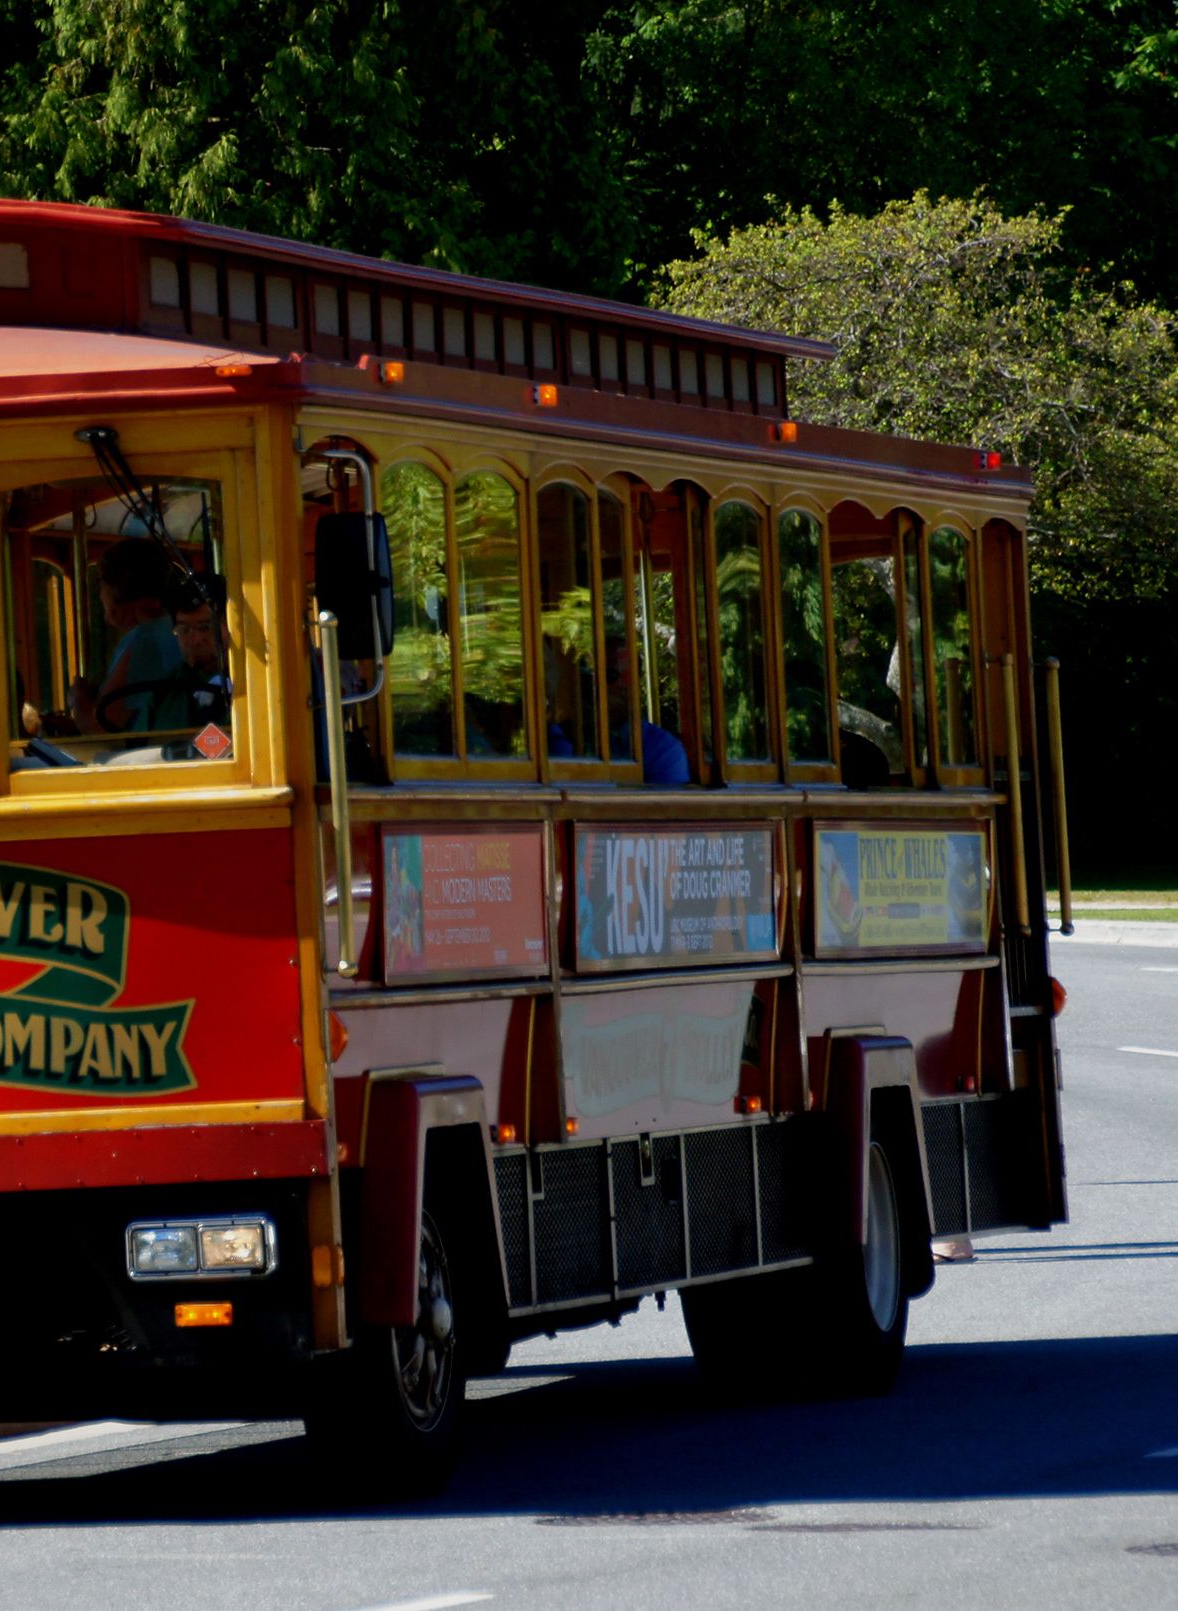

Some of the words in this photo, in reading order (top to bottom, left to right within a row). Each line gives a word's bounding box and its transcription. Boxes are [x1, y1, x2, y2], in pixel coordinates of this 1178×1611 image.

[669, 840, 687, 868] THE
[688, 839, 705, 866] ART
[706, 838, 726, 866] AND
[726, 838, 745, 866] LIFE
[859, 837, 897, 880] PRINCE
[903, 837, 946, 880] WHALES
[441, 877, 475, 905] MODERN
[476, 875, 512, 903] MASTERS
[670, 873, 682, 900] OF
[683, 872, 709, 900] DOUG
[709, 869, 752, 898] CRANMER
